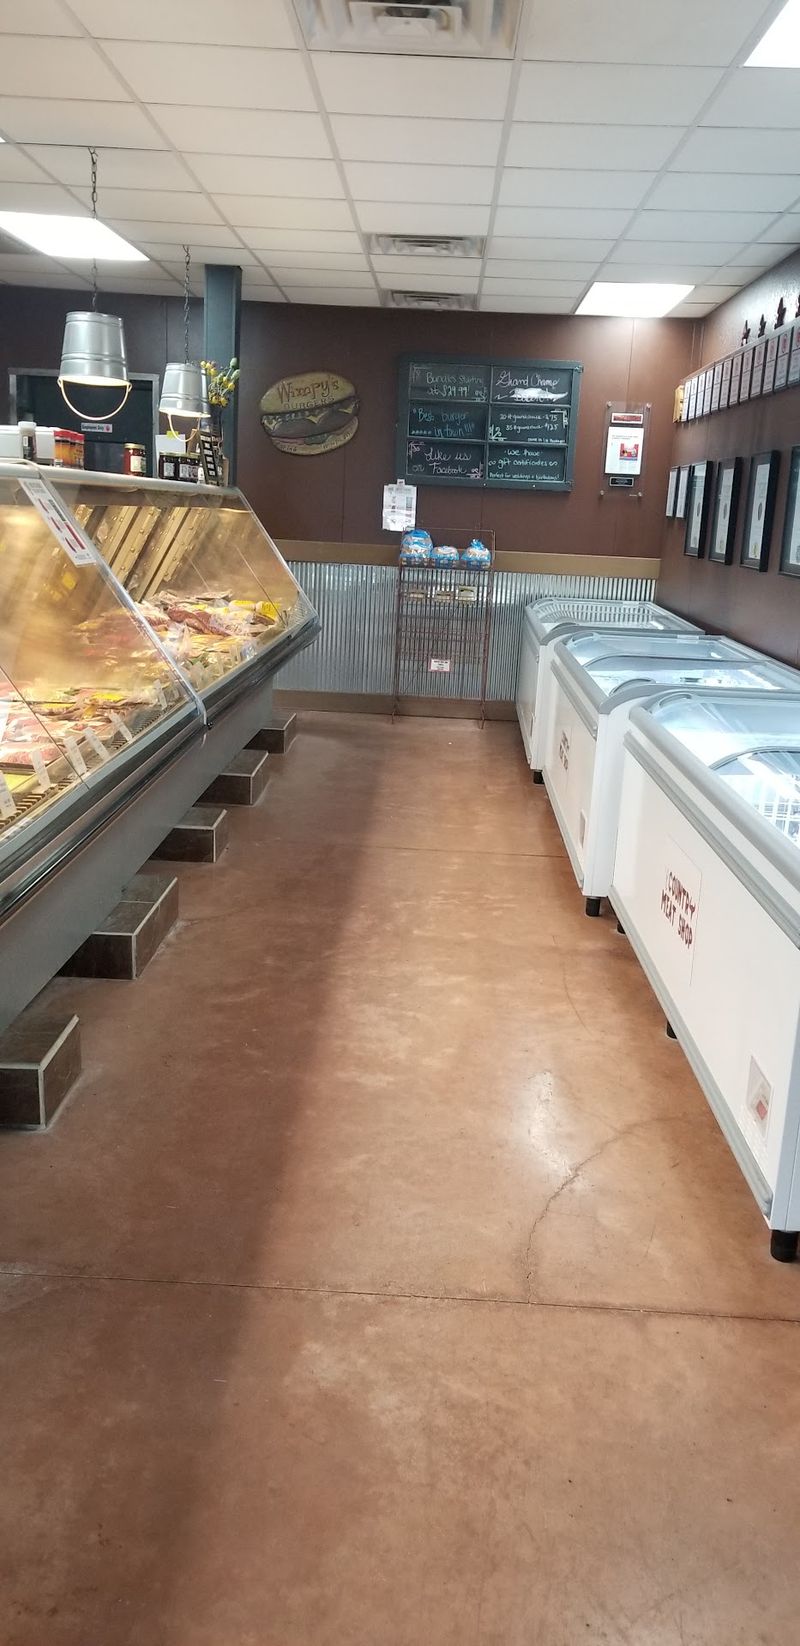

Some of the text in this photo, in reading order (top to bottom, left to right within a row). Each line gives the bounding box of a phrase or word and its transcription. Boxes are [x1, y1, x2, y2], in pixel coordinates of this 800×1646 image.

[495, 370, 529, 388] Grand
[277, 377, 340, 404] Wimpy's
[424, 447, 472, 461] Like us
[497, 458, 511, 469] gift
[667, 870, 697, 921] COUNTRY
[660, 889, 693, 950] MEAT SHOP
